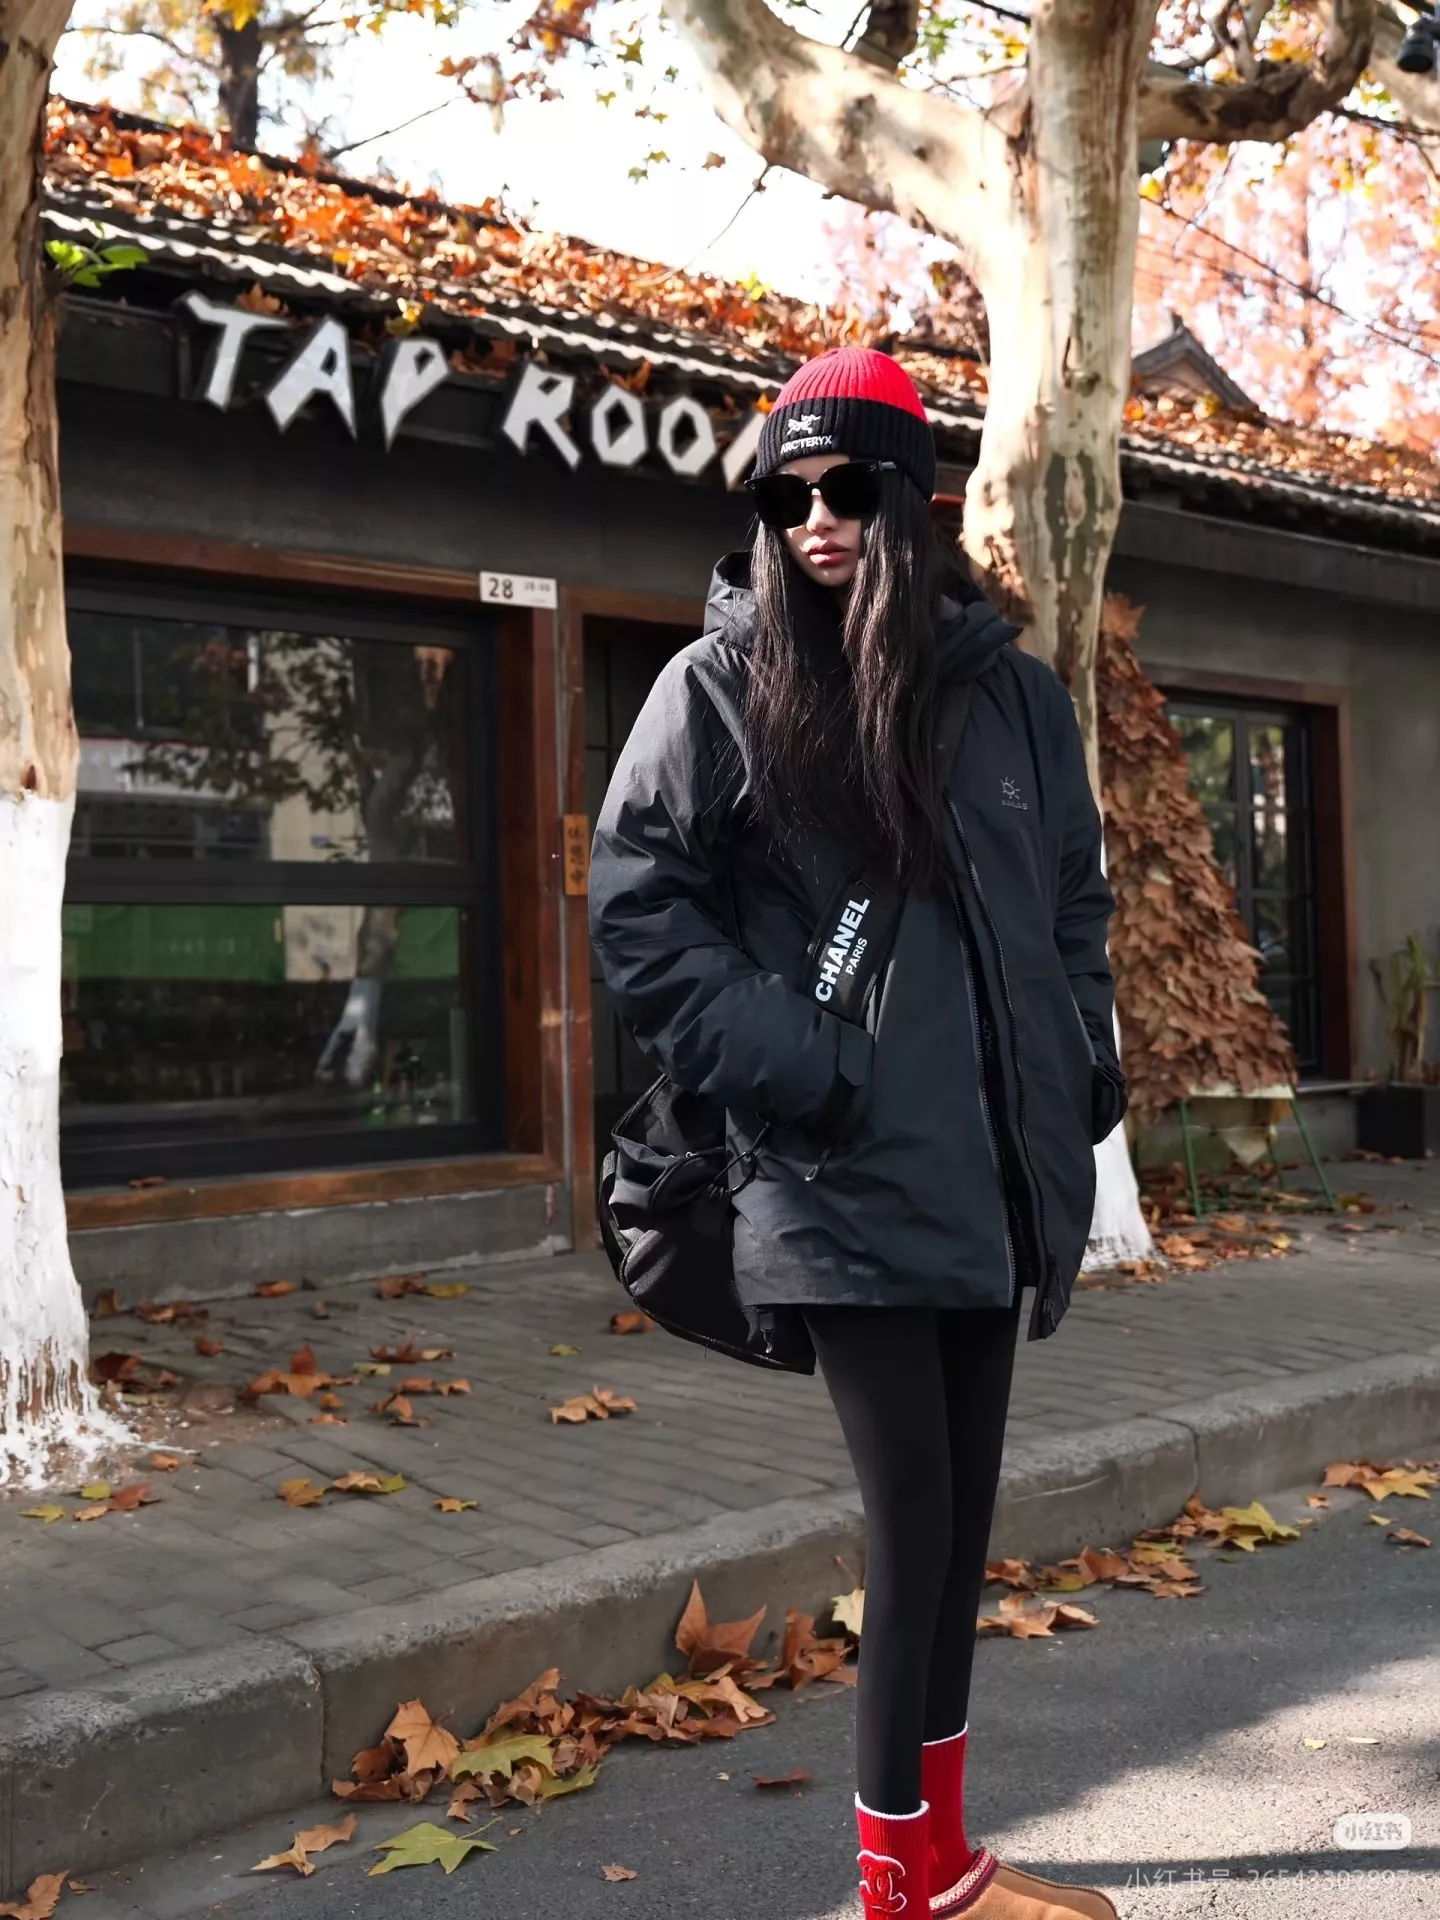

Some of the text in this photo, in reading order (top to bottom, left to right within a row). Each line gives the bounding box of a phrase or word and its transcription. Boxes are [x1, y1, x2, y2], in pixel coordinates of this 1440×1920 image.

[187, 290, 451, 452] TAP
[488, 577, 514, 600] 28
[815, 898, 871, 1002] CHANEL
[845, 937, 868, 976] PARIS
